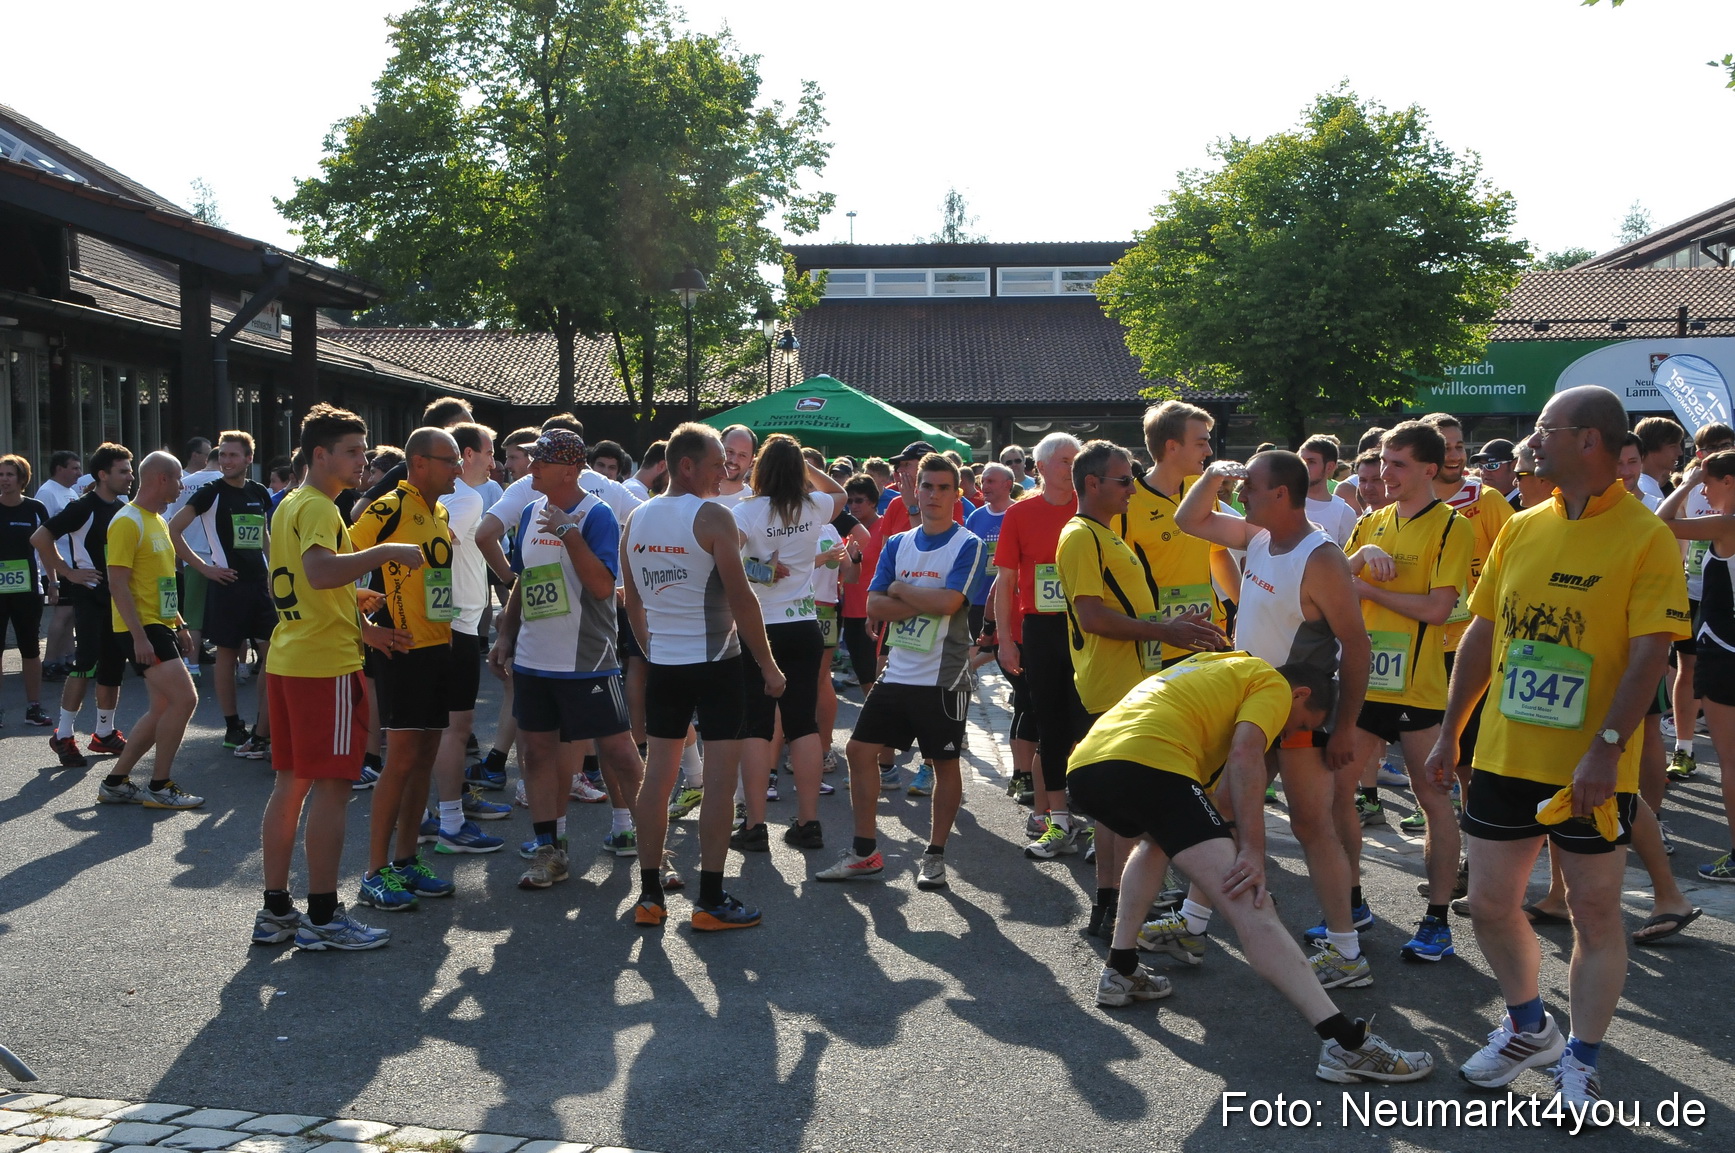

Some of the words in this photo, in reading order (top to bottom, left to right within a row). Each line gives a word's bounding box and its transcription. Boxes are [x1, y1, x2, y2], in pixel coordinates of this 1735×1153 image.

[1625, 387, 1663, 398] Lamm
[753, 419, 851, 429] Lammsbräu
[769, 413, 842, 421] Neumarkter
[238, 526, 260, 541] 972
[648, 545, 690, 555] KLEBL
[0, 571, 25, 585] 965
[641, 566, 689, 591] Dynamics
[1251, 574, 1276, 595] KLEBL
[525, 582, 559, 608] 528
[1505, 667, 1585, 709] 1347
